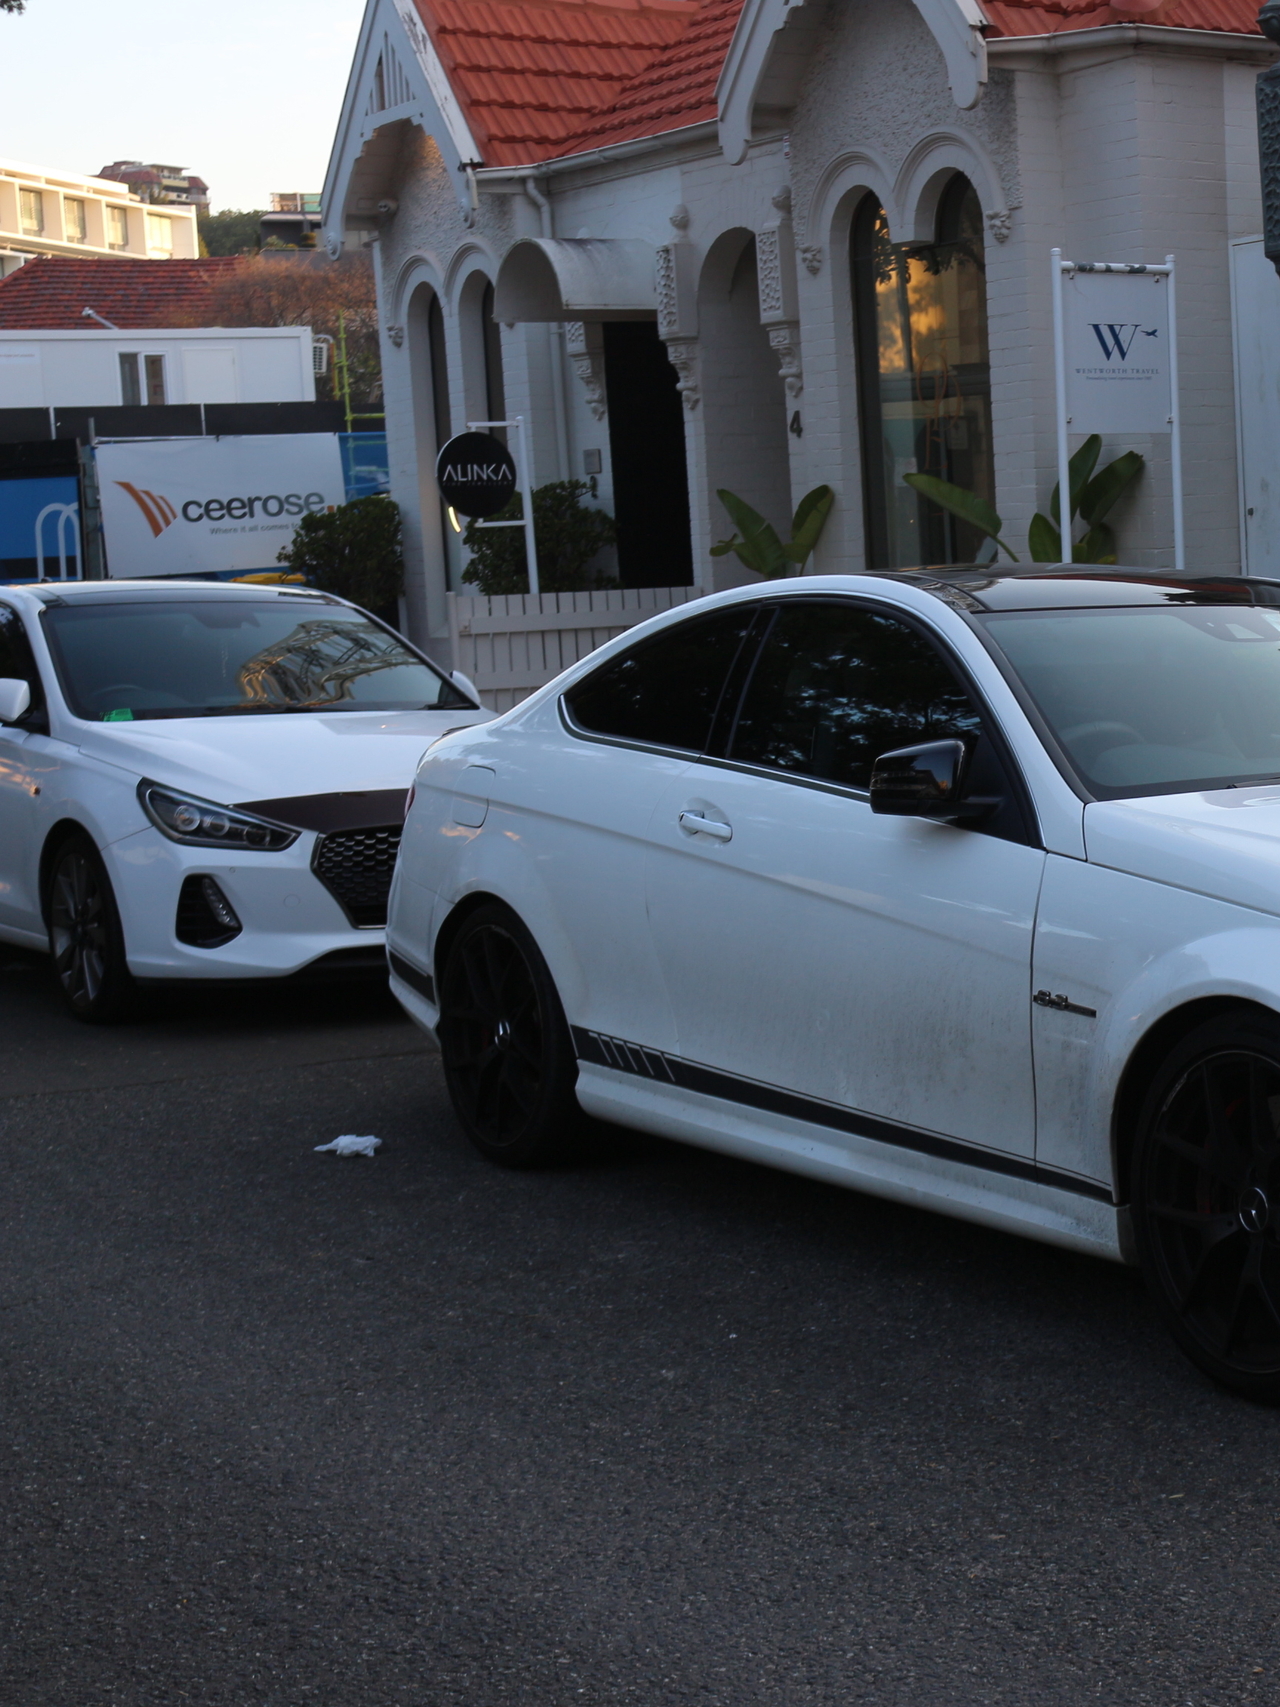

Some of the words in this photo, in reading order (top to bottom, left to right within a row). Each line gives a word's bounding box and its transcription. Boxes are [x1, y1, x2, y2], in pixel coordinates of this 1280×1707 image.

[789, 410, 803, 439] 4
[443, 463, 513, 481] ALINKA
[209, 526, 239, 535] Where
[240, 525, 247, 533] it
[248, 524, 259, 533] all
[260, 523, 290, 532] comes
